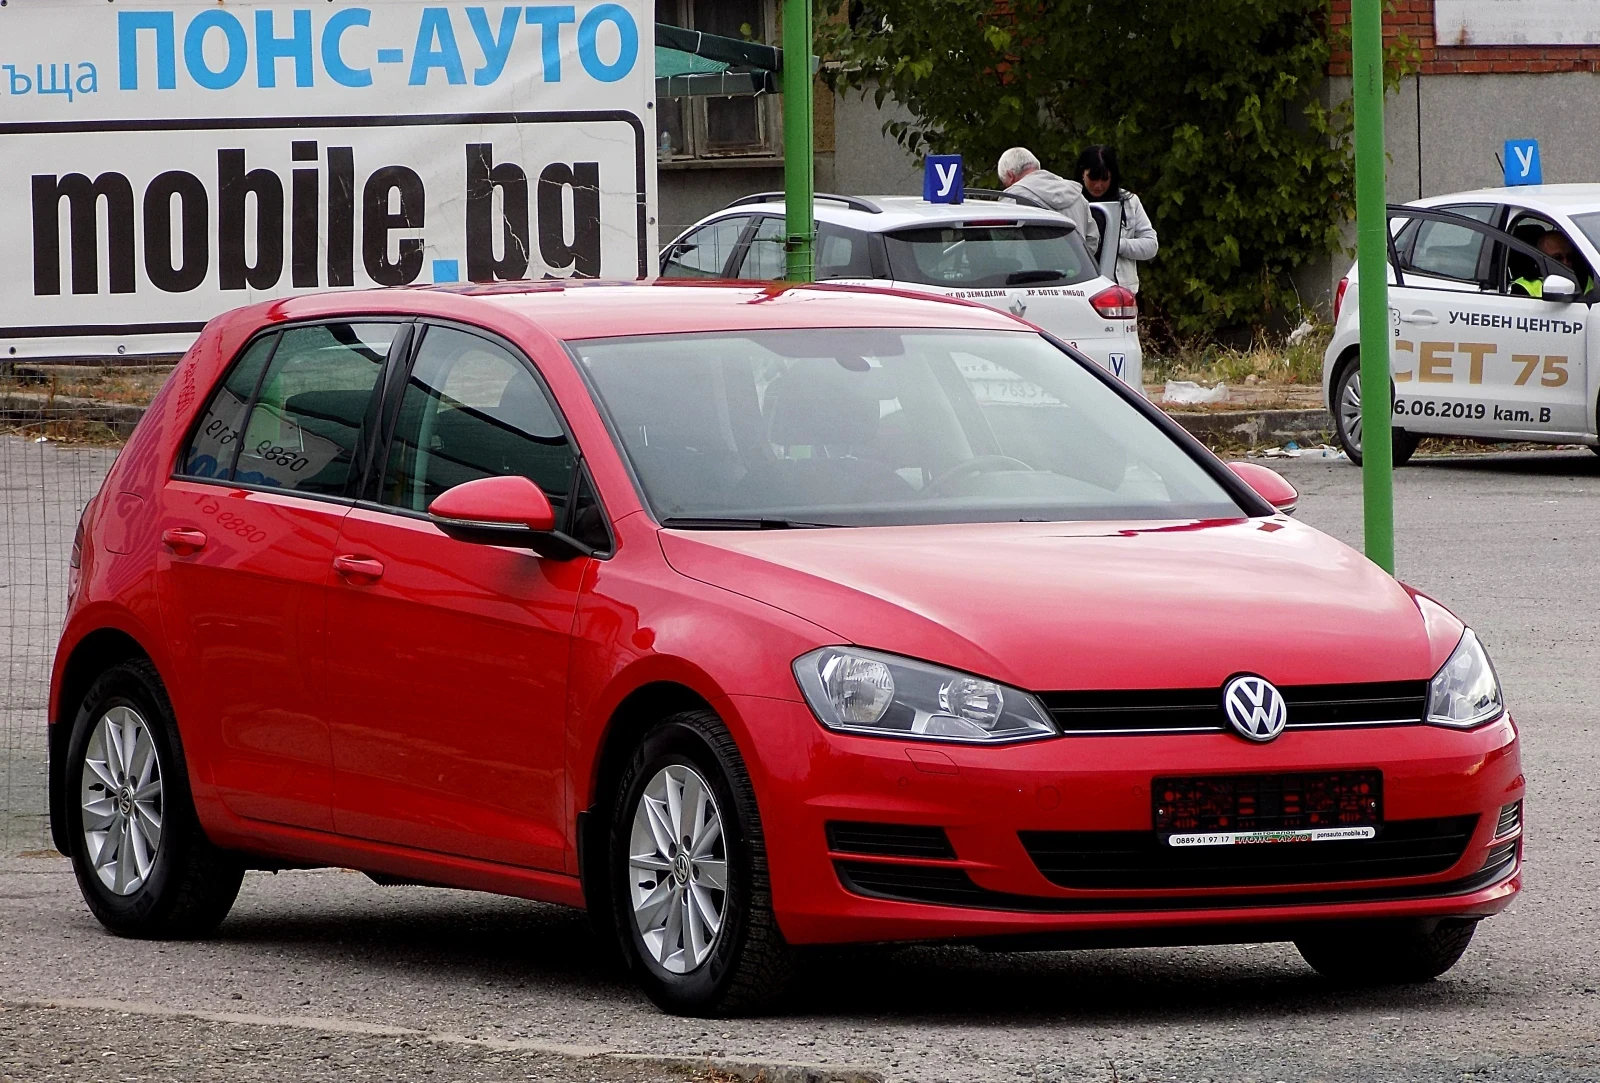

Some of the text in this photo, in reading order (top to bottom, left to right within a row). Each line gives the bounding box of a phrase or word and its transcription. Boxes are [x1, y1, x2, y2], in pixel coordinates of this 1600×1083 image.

[0, 4, 639, 102] ъща ПОНС-АУТО
[31, 141, 603, 296] mobile.bg
[966, 290, 1007, 298] ЗЕМЕДЕЛИЕ
[1449, 310, 1583, 335] УЧЕБЕН ЦЕНТЪР
[1512, 354, 1569, 387] 75
[1176, 837, 1195, 845] 0889
[1197, 836, 1206, 844] 61
[1316, 830, 1369, 839] ponsauto.mobile.bg
